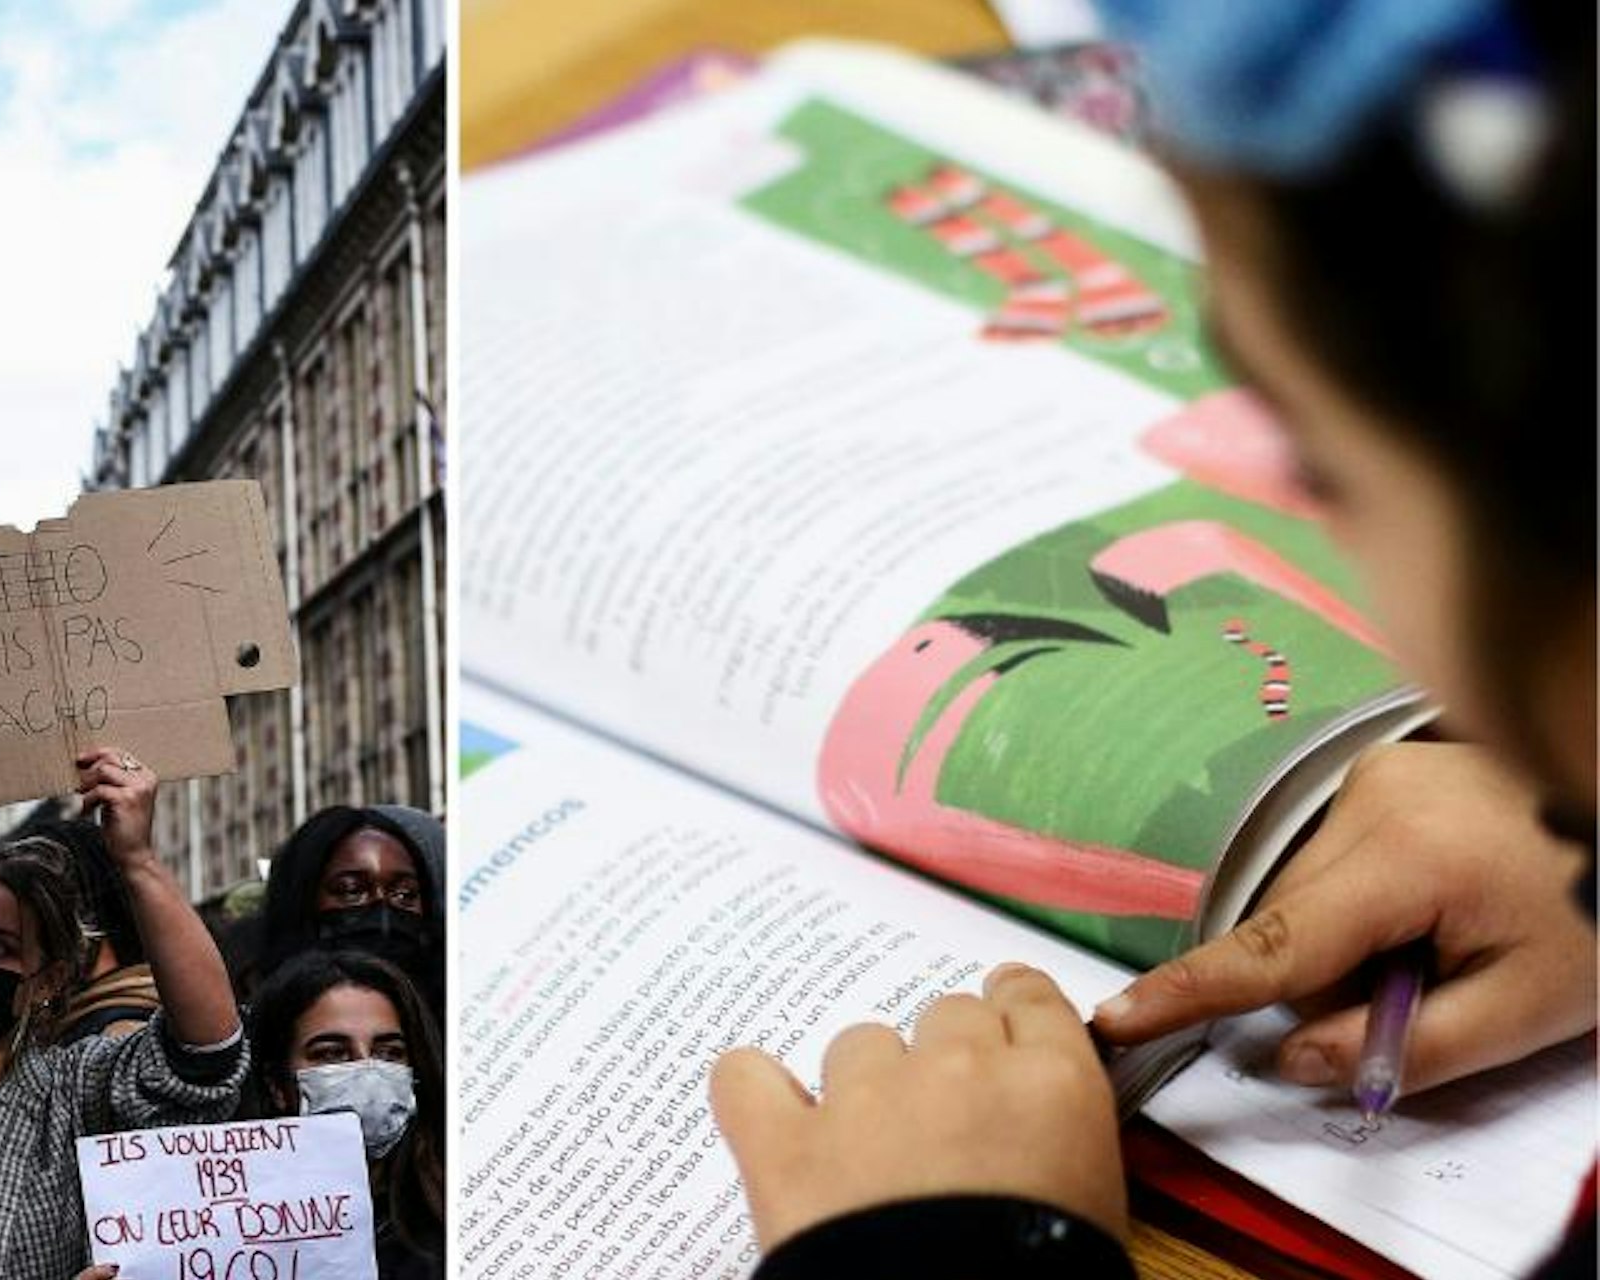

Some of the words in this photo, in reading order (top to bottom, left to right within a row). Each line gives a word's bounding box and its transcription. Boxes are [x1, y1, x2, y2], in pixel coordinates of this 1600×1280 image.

[62, 613, 143, 668] PAS
[97, 1134, 146, 1167] ILS
[157, 1124, 300, 1155] VOULAIENT
[460, 1122, 533, 1198] adornarse
[569, 1056, 590, 1075] se
[464, 1062, 522, 1124] estaban
[465, 1198, 530, 1263] escamas
[528, 1174, 551, 1196] de
[550, 1106, 611, 1175] pescado
[610, 1081, 632, 1103] en
[628, 1039, 667, 1078] todo
[497, 1119, 568, 1188] fumaban
[567, 1055, 624, 1115] cigarros
[522, 1221, 540, 1238] si
[616, 1095, 653, 1134] cada
[650, 1062, 680, 1091] vez
[679, 1028, 708, 1059] que
[708, 963, 769, 1028] pasaban
[592, 1149, 672, 1239] perfumado
[669, 1106, 708, 1147] todo
[773, 1009, 790, 1022] y
[787, 935, 871, 1009] caminaban
[620, 1210, 654, 1243] una
[646, 1150, 704, 1209] llevaba
[803, 1004, 828, 1027] un
[196, 1158, 249, 1198] 1939
[533, 1232, 565, 1255] los
[565, 1157, 634, 1231] pescados
[628, 1129, 656, 1153] les
[655, 1058, 713, 1128] gritaban
[94, 1214, 144, 1246] ON
[156, 1207, 221, 1245] LEUR
